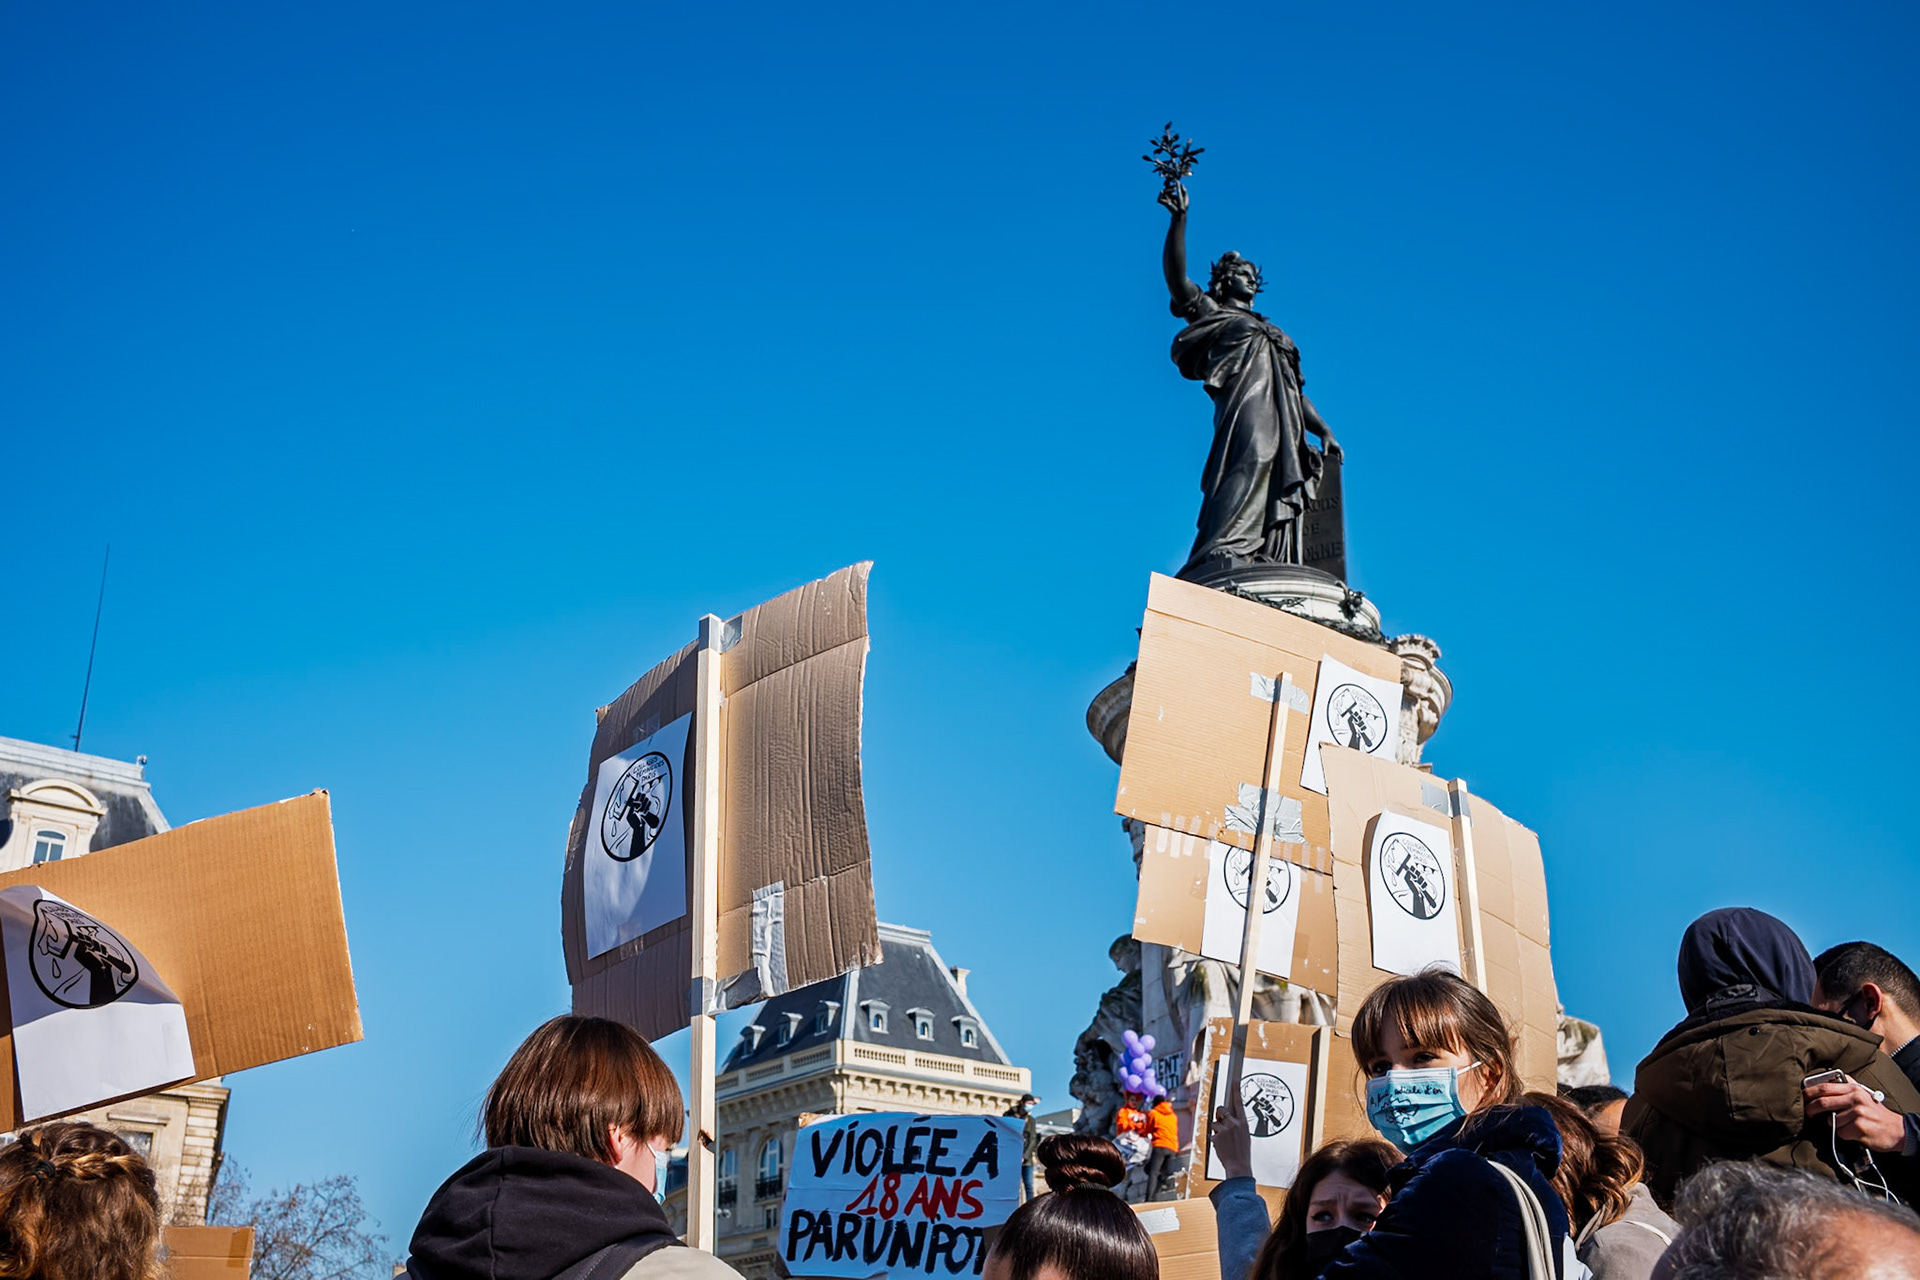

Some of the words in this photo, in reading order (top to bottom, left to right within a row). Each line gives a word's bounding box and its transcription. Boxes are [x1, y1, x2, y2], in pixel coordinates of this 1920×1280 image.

[961, 1118, 999, 1180] À
[846, 1171, 902, 1220] 18
[904, 1175, 984, 1221] ANS
